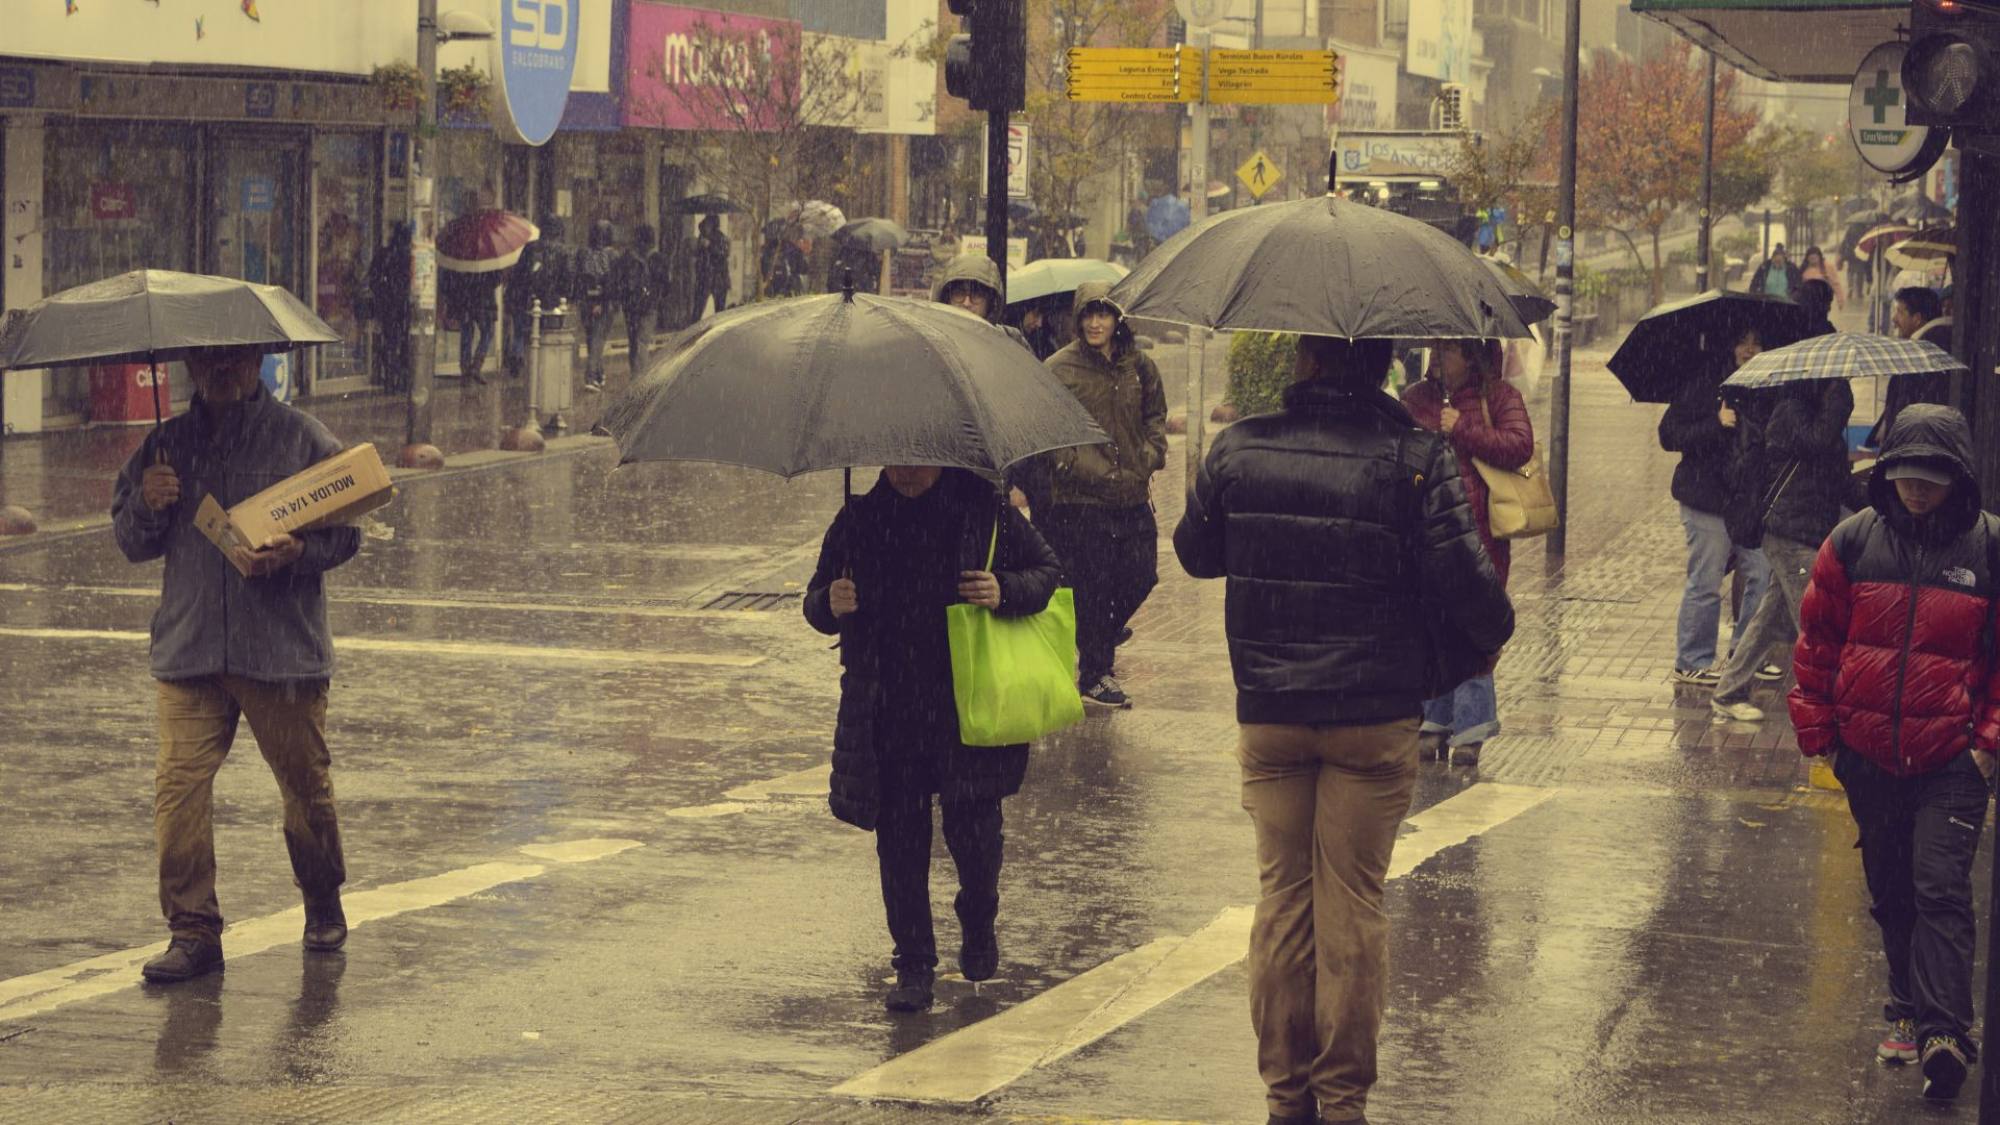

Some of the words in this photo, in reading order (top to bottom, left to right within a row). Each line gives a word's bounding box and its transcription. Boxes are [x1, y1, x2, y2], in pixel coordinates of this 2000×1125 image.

[308, 474, 356, 500] MOLIDA
[290, 496, 309, 514] 1/4
[270, 508, 289, 521] KG
